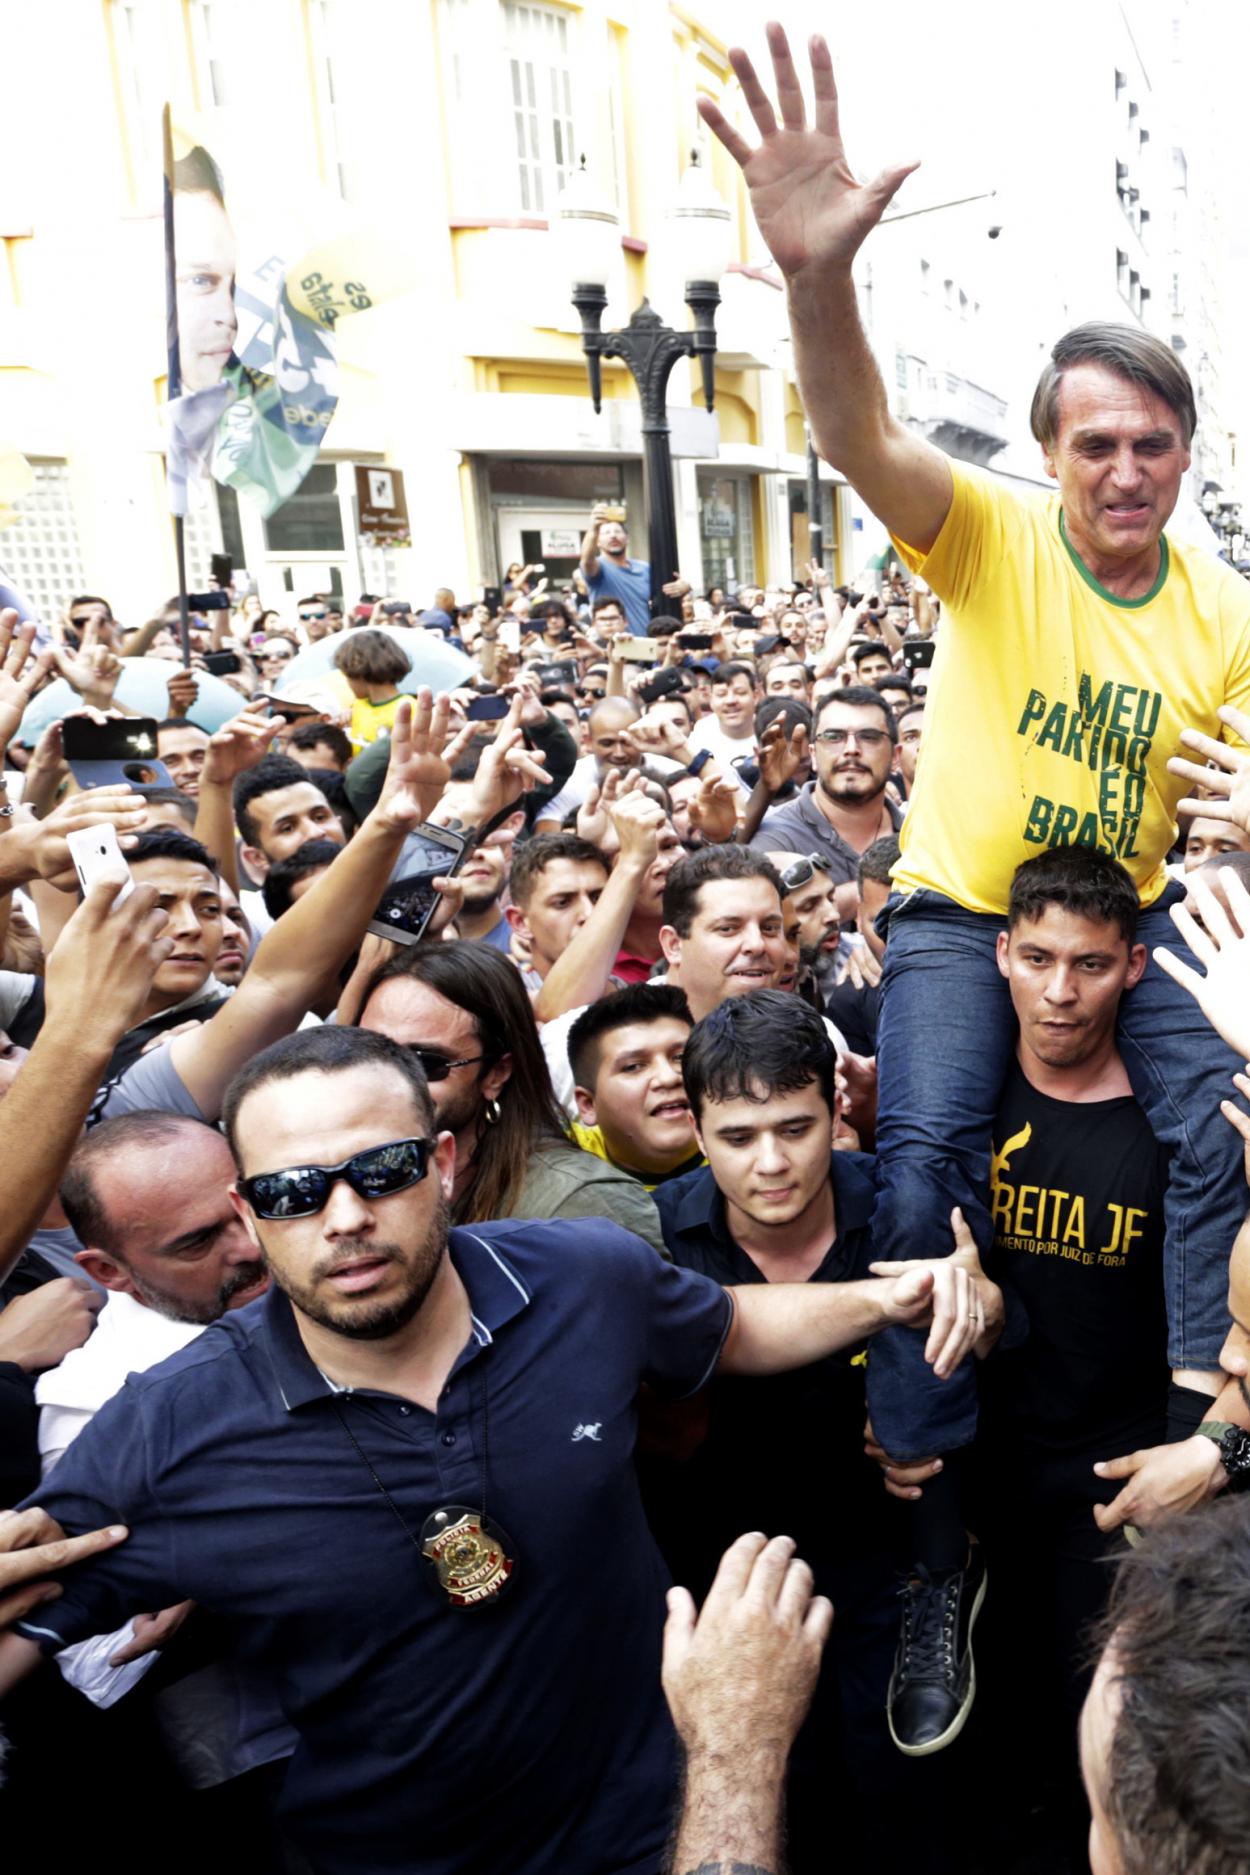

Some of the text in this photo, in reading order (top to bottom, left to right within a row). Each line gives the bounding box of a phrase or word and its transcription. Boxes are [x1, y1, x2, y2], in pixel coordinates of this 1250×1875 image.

[1078, 673, 1162, 738] MEU
[1099, 764, 1146, 818] É O
[1101, 1202, 1149, 1254] JF
[1036, 1241, 1058, 1255] POR
[1060, 1245, 1081, 1262] JUIZ
[1082, 1252, 1096, 1265] DE
[1097, 1253, 1126, 1267] FORA
[458, 1561, 494, 1587] FEDERAL
[464, 1568, 508, 1603] AGENTE
